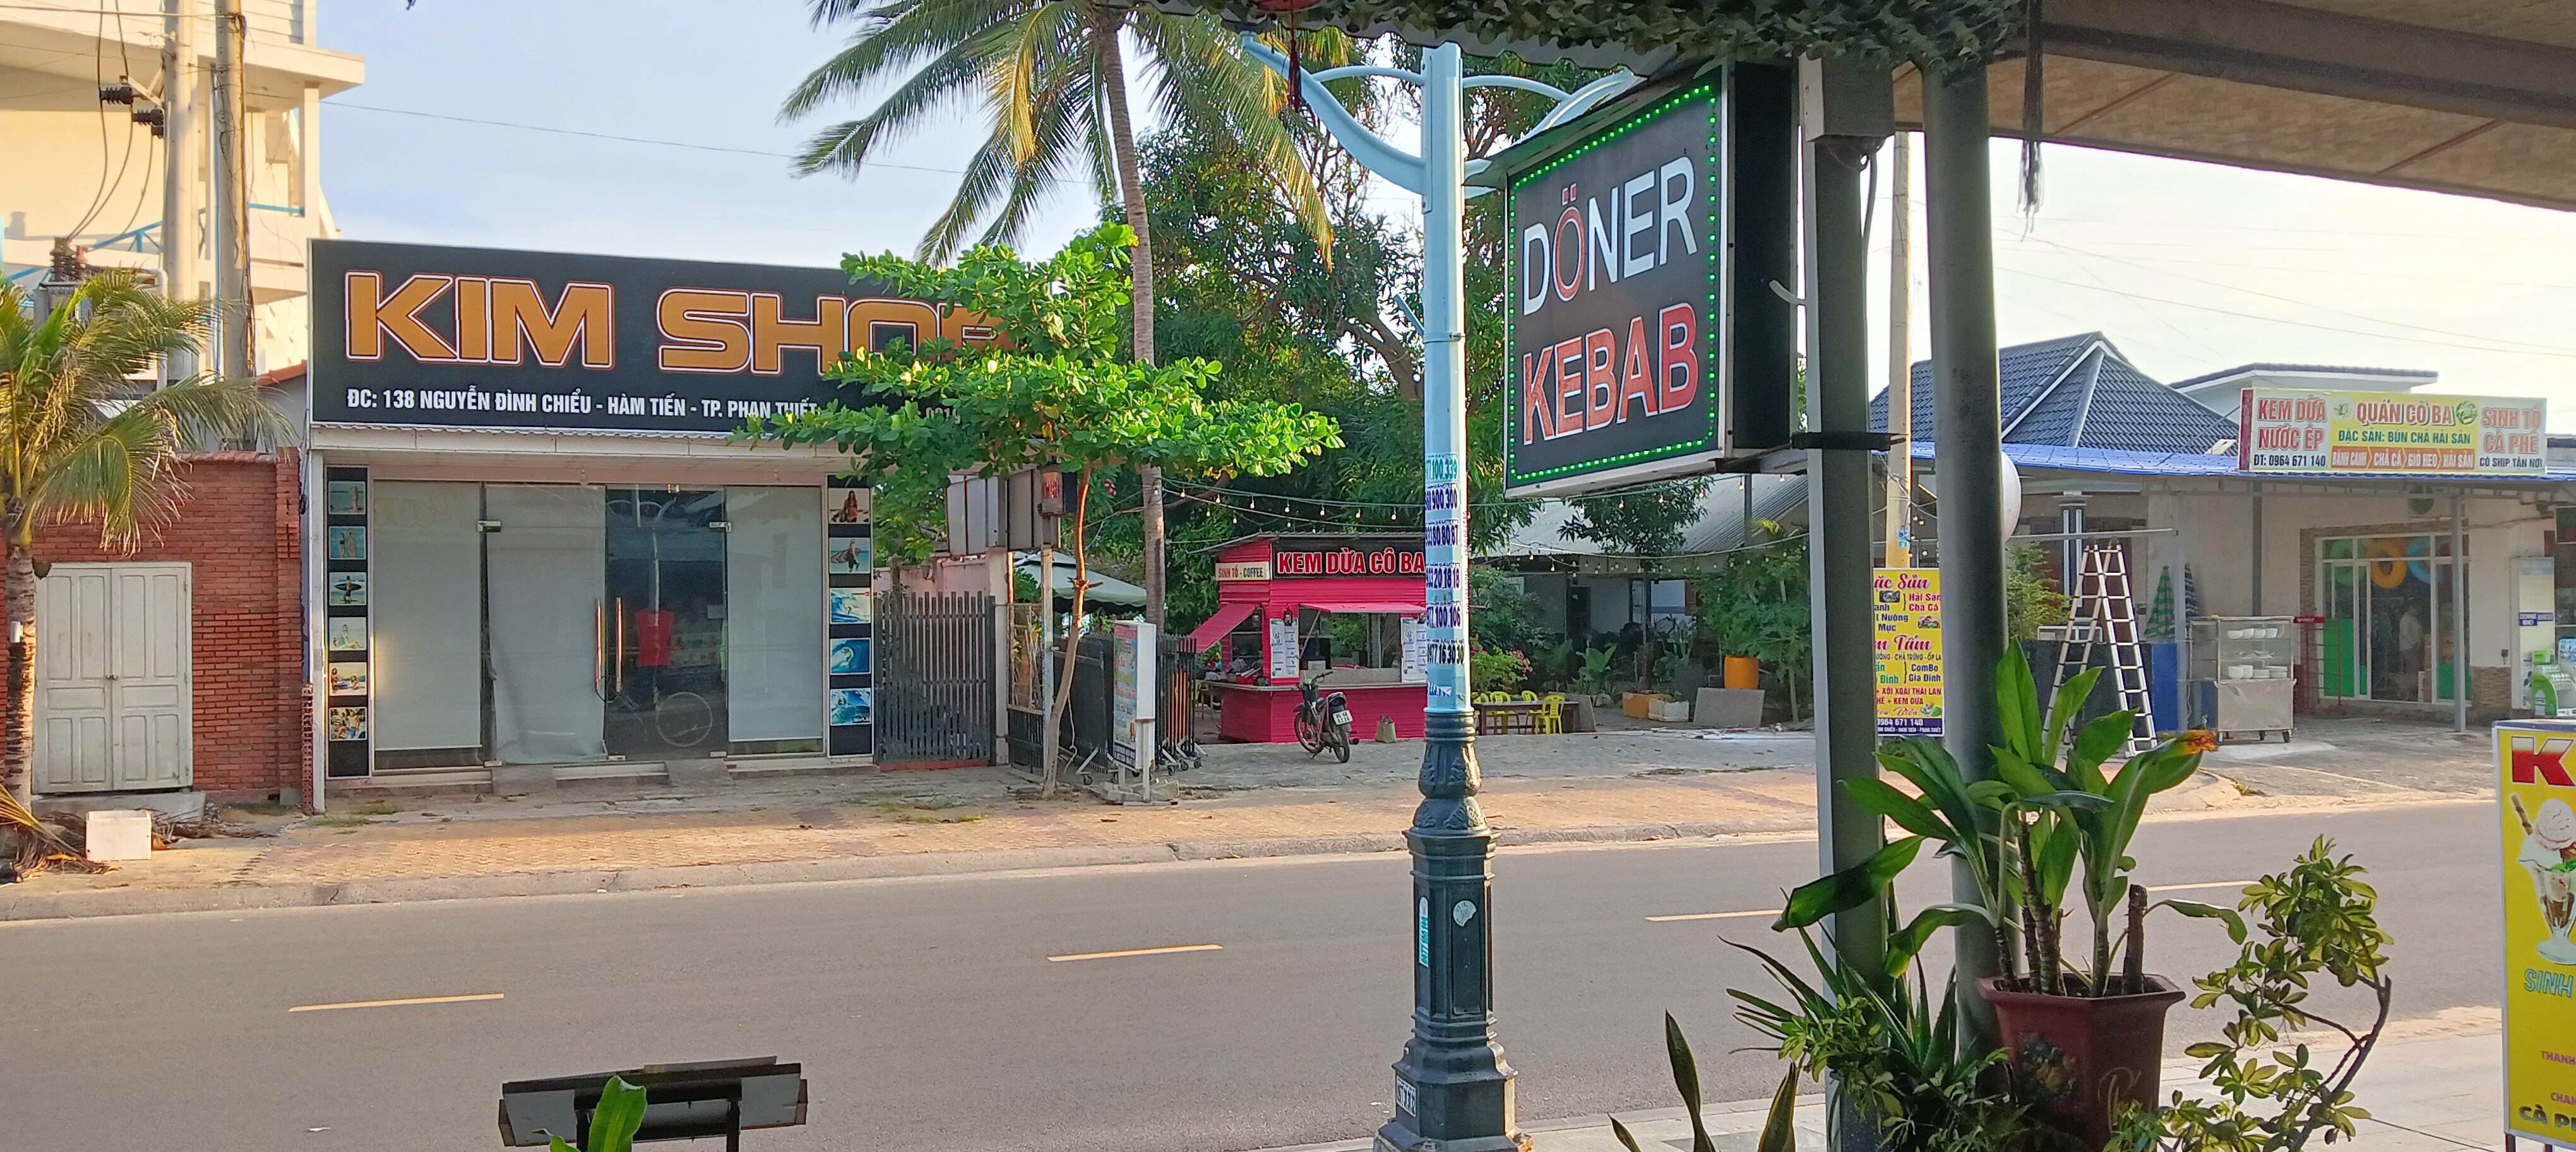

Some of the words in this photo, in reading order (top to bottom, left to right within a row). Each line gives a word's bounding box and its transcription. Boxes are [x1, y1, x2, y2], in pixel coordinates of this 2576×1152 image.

[1523, 155, 1698, 316] DÖNER
[344, 270, 616, 370] KIM
[1523, 302, 1699, 445] KEBAB
[347, 388, 378, 408] ĐC:
[383, 390, 415, 409] 138
[420, 385, 490, 411] NGUYỄN
[495, 389, 537, 412] ĐÌNH
[542, 388, 592, 414] CHIỂU
[607, 393, 645, 416] HÀM
[650, 393, 686, 416] TIẾN
[701, 399, 724, 418] TP.
[727, 400, 771, 419] PHAN
[2258, 397, 2293, 422] KEM
[2357, 399, 2404, 426] QUÁN
[2406, 400, 2431, 426] CÔ
[2431, 404, 2456, 426] BA
[2482, 407, 2520, 429] SINH
[2522, 404, 2542, 429] TỐ
[2258, 423, 2301, 450] NƯỚC
[2303, 423, 2324, 451] ÉP
[2339, 428, 2359, 444] ĐẶC
[2361, 427, 2385, 443] SẢN:
[2388, 429, 2408, 443] BÚN
[2508, 430, 2539, 454] PHÊ
[2253, 454, 2267, 466] ĐT:
[2269, 455, 2289, 466] 0964
[2292, 455, 2307, 467] 671
[2311, 455, 2326, 467] 140
[2492, 457, 2510, 467] SHIP
[1277, 551, 1322, 574] KEM
[1327, 547, 1368, 574] DỪA
[1369, 547, 1397, 575] CÔ
[1399, 551, 1427, 574] BA
[1218, 568, 1231, 579] SINH
[1243, 567, 1263, 579] COFFEE
[1878, 623, 1897, 633] Mực
[1881, 613, 1909, 623] Nướng
[1893, 635, 1930, 651] Tấm
[1909, 674, 1921, 682] Gia
[1911, 664, 1939, 672] ComBo
[1893, 697, 1909, 705] KEM
[1928, 687, 1941, 695] LAN
[1895, 718, 1907, 726] 671
[1911, 718, 1924, 726] 140
[2511, 736, 2576, 787] K
[2524, 968, 2575, 999] SINH
[2520, 1103, 2549, 1125] CÀ
